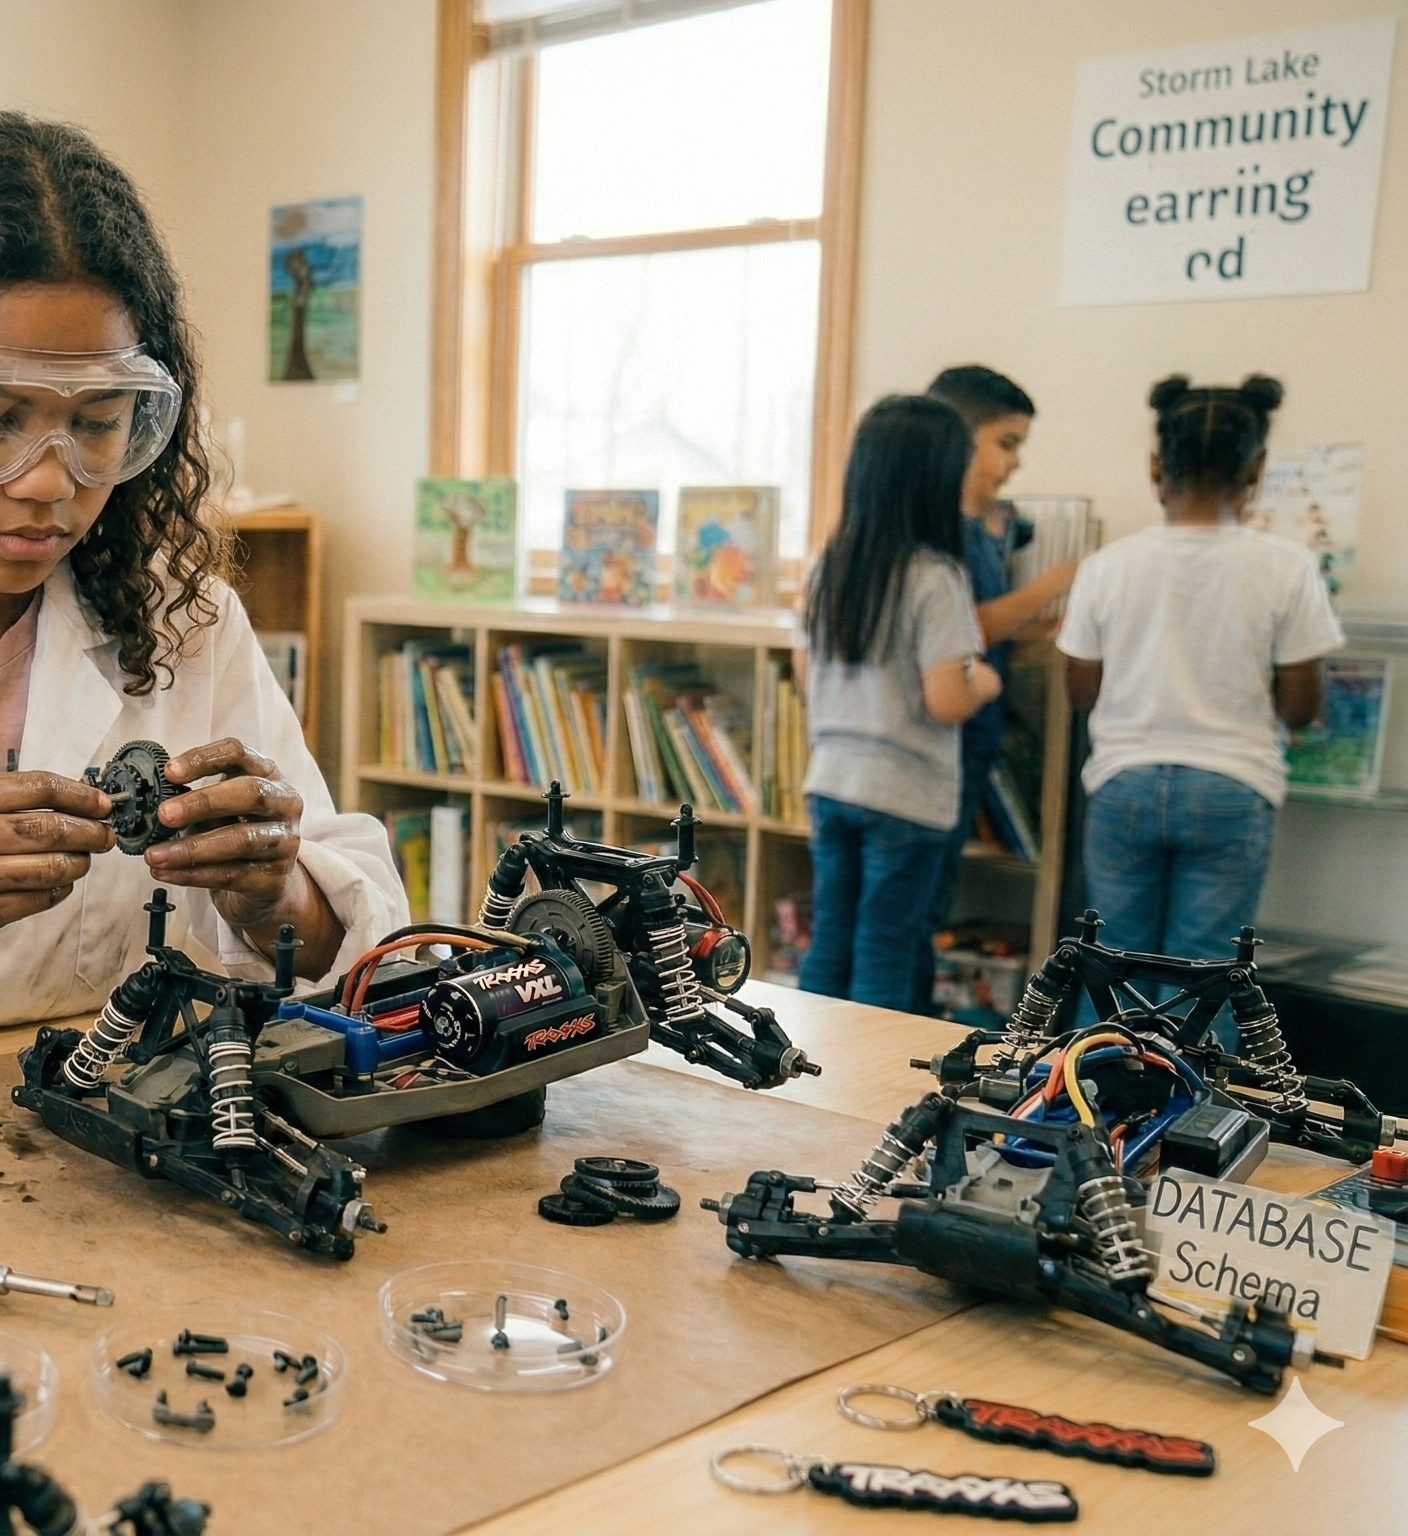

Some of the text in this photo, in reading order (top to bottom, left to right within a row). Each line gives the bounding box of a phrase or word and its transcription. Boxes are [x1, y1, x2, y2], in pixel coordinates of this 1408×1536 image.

[1139, 50, 1320, 99] Storm Lake
[1092, 91, 1369, 159] Community
[514, 975, 562, 1003] VXL
[1152, 1176, 1379, 1272] DATABASE
[1169, 1240, 1320, 1320] Schema
